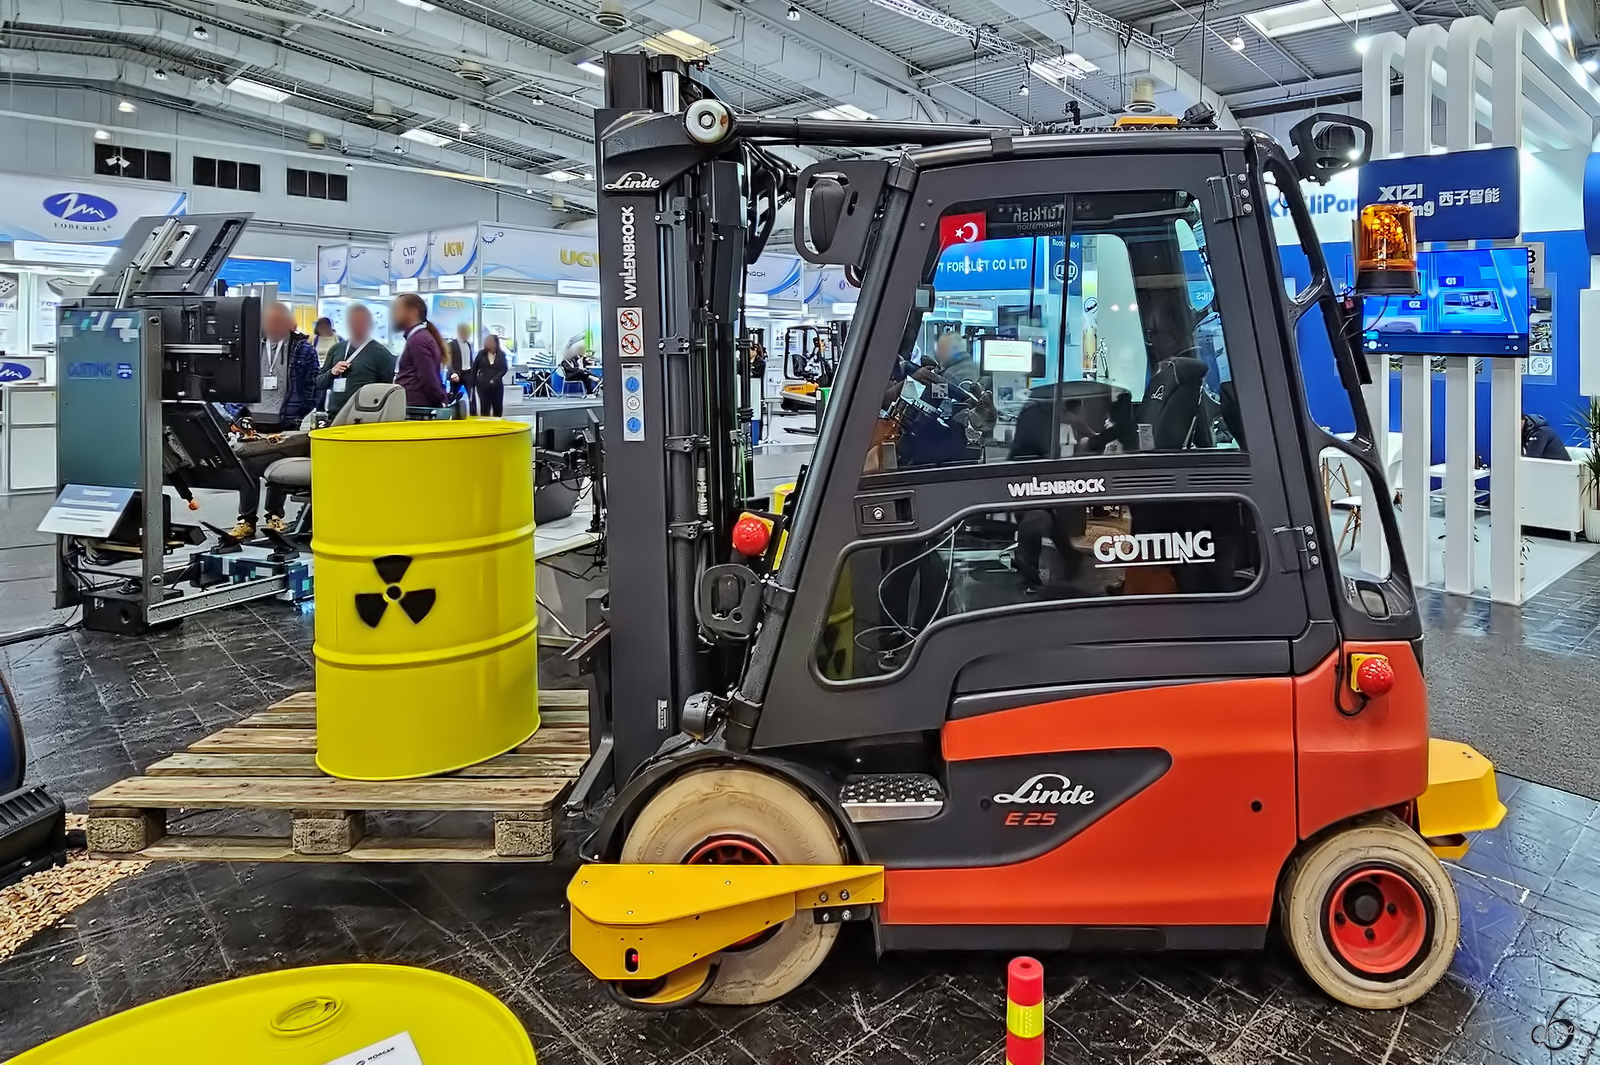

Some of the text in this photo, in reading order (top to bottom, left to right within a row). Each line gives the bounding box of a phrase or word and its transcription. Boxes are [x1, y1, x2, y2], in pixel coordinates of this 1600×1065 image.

[604, 171, 660, 189] Linde
[1378, 184, 1423, 202] XIZI
[1439, 188, 1500, 207] 西子智能
[443, 241, 464, 257] UGW
[618, 206, 637, 300] WILLENBROCK
[992, 259, 1007, 271] CO
[1009, 258, 1028, 270] LTD
[1007, 476, 1106, 498] WILLENBROCK
[1093, 530, 1216, 566] GÖTTING
[992, 773, 1096, 805] Linde
[1004, 812, 1059, 826] E 25
